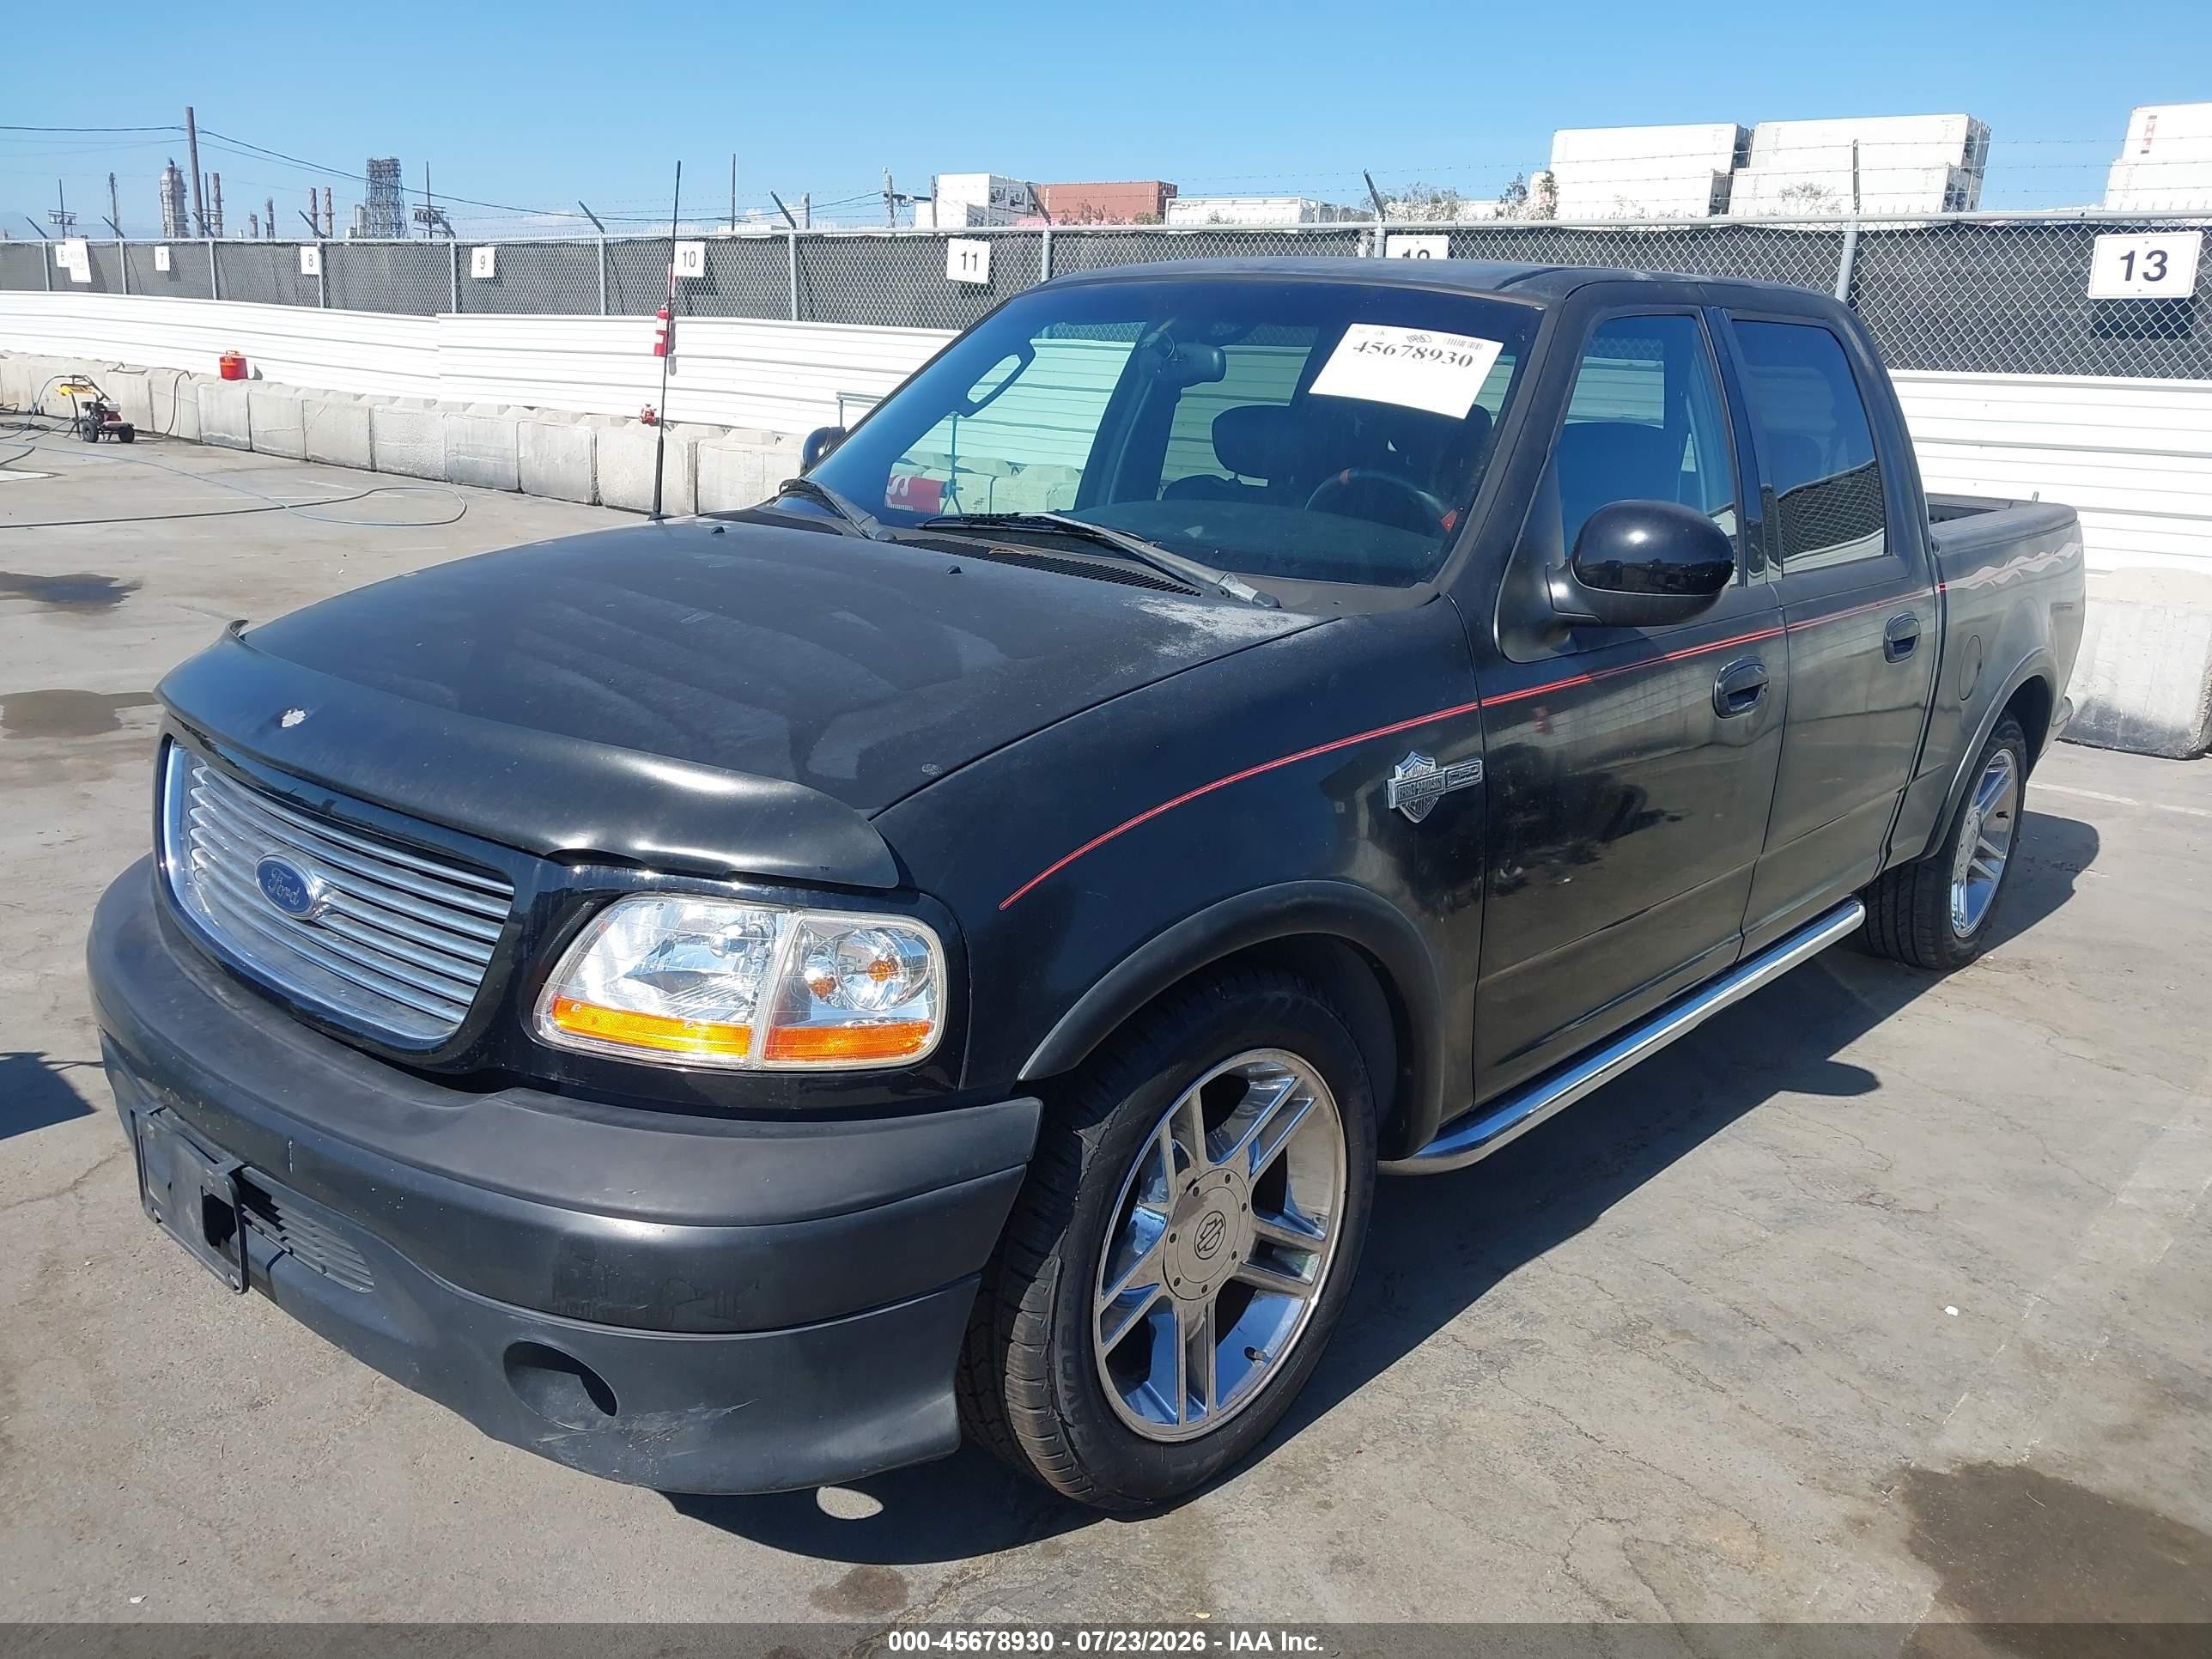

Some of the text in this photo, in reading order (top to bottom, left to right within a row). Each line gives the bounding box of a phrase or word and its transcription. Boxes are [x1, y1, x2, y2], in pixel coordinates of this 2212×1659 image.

[160, 252, 164, 265] 7
[308, 253, 313, 267] 8
[480, 254, 486, 270] 9
[682, 250, 696, 268] 10
[960, 250, 978, 272] 11
[2119, 249, 2168, 282] 13
[1353, 340, 1474, 368] 45678930
[267, 867, 301, 906] Ford
